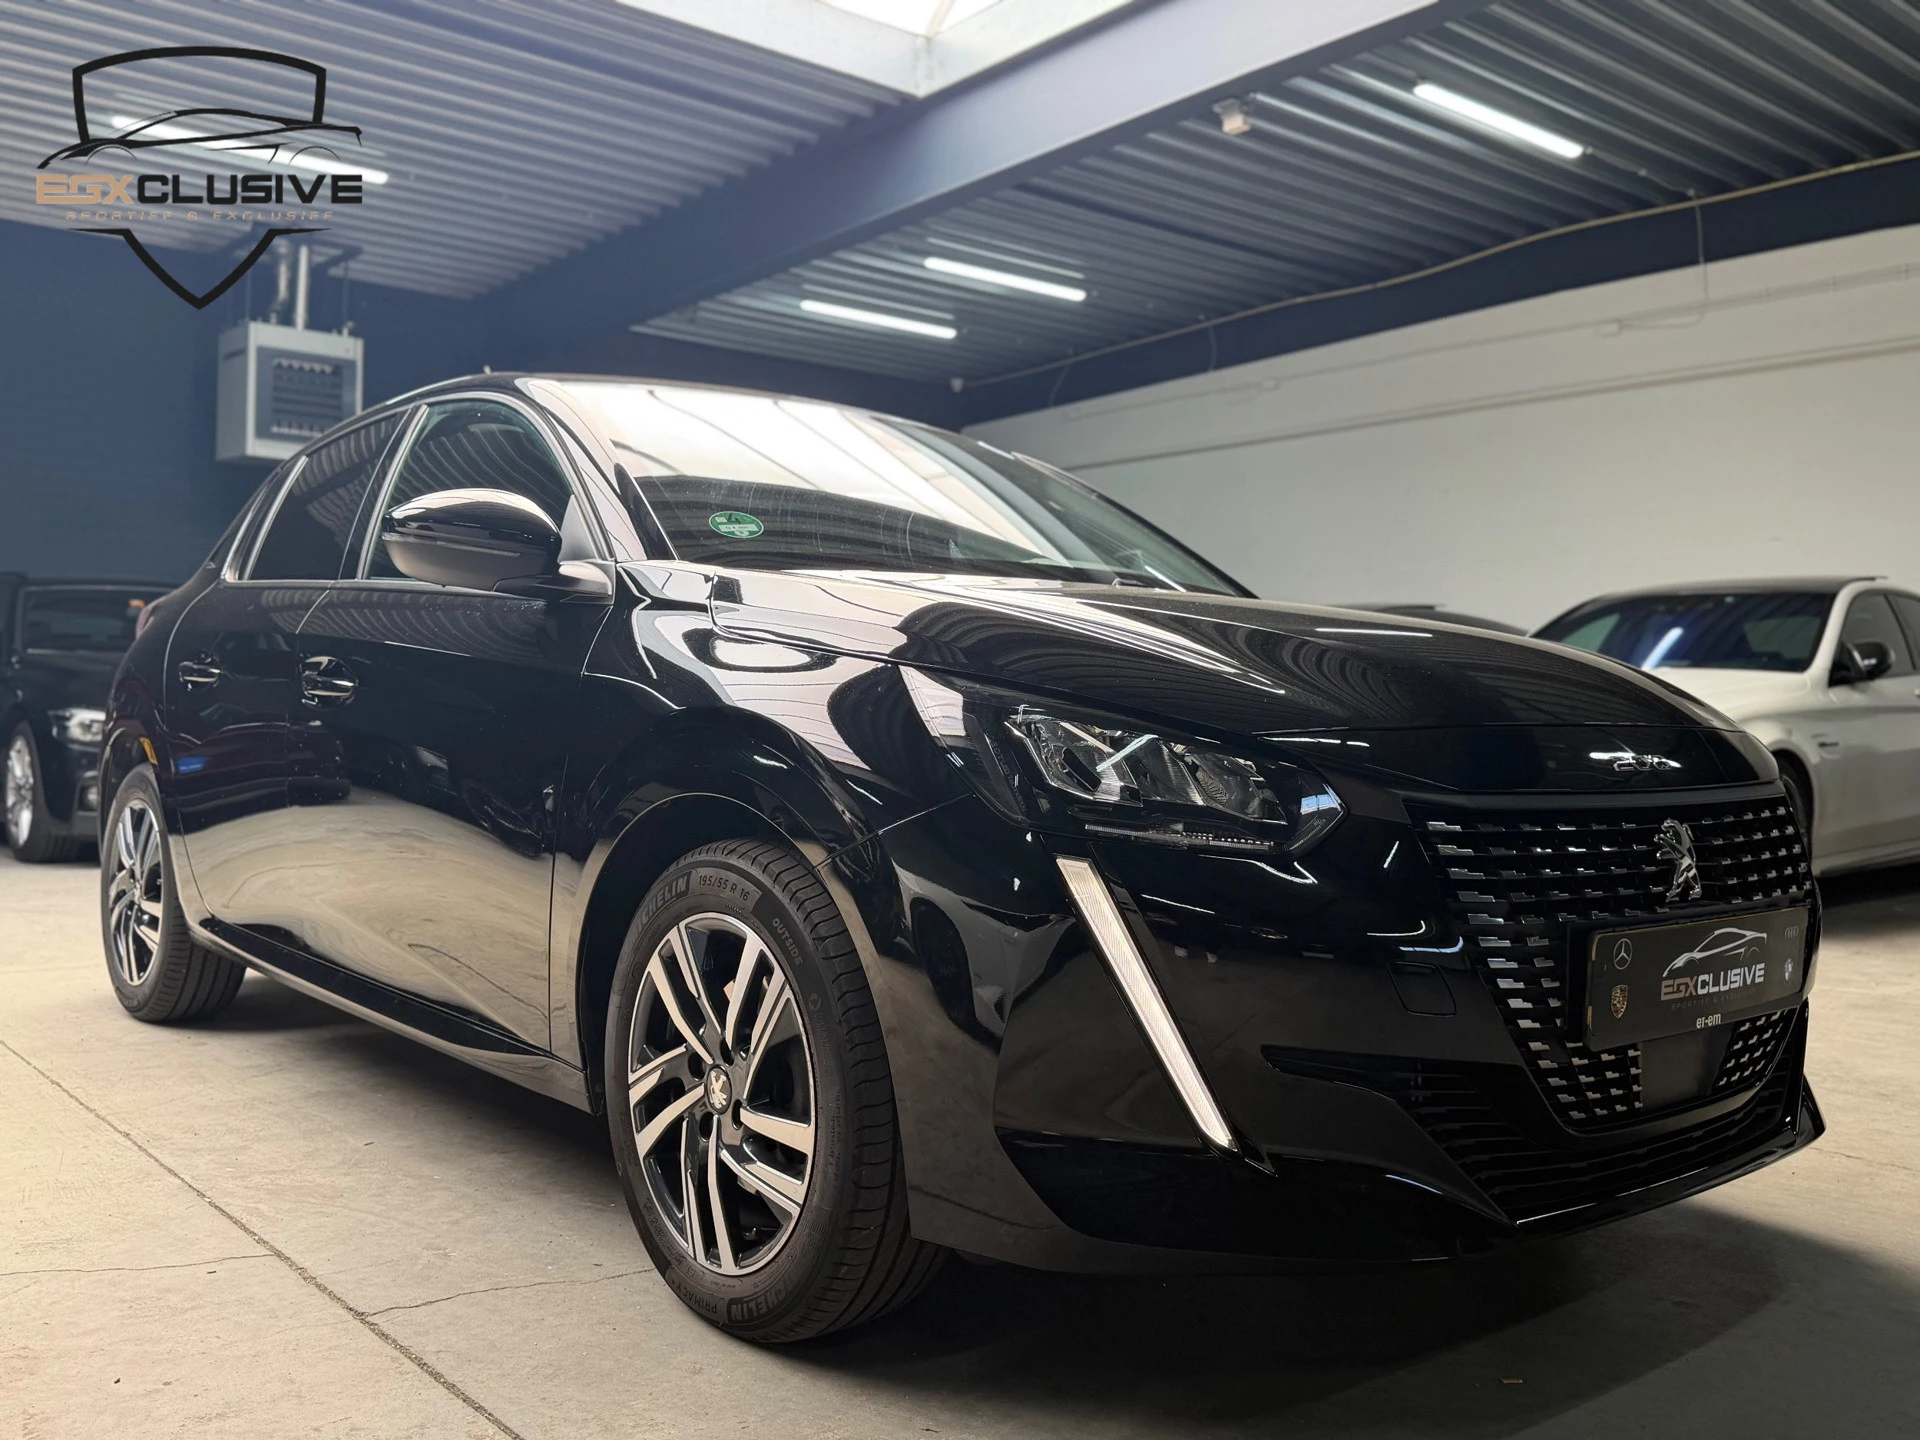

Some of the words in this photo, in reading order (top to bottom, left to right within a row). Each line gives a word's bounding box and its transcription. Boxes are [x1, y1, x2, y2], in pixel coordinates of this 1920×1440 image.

[698, 874, 729, 891] 195/55
[730, 883, 737, 895] R
[740, 888, 751, 902] 16
[772, 917, 803, 967] OUTSIDE
[1661, 963, 1765, 1000] EGXCLUSIVE
[676, 1282, 716, 1314] PRIMACY
